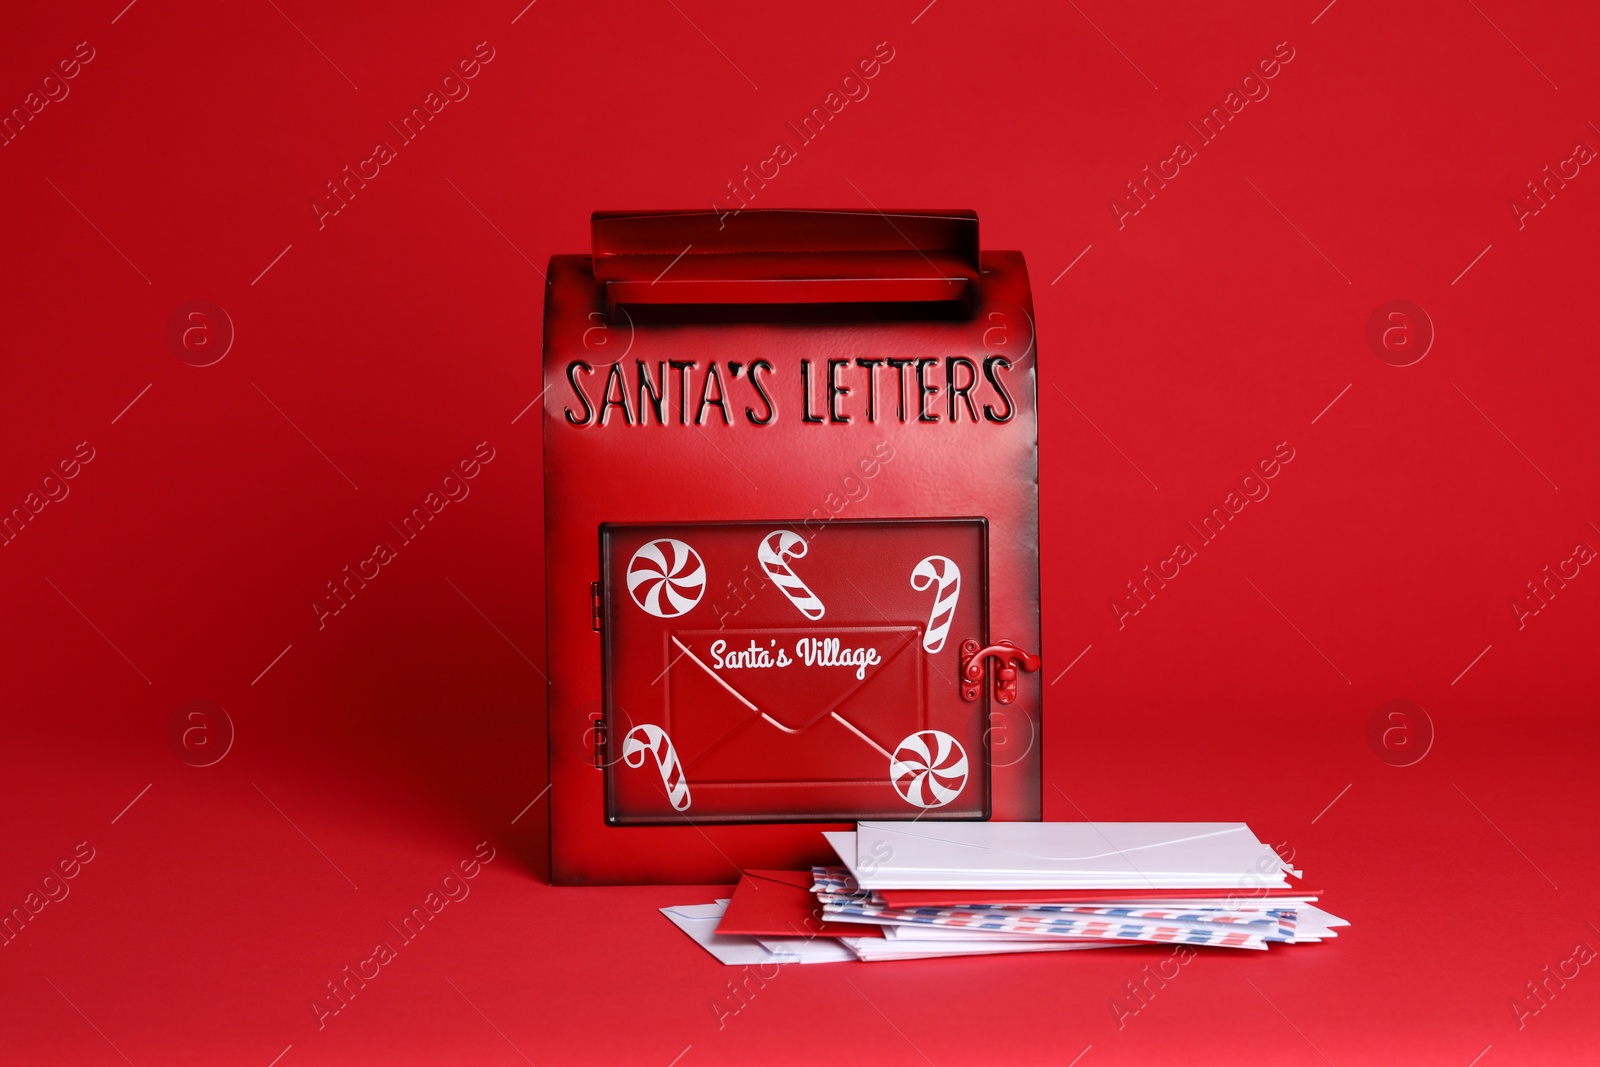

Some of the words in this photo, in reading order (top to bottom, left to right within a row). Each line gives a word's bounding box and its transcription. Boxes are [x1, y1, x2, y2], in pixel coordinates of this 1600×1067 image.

[564, 358, 779, 427] SANTA'S
[800, 354, 1017, 425] LETTERS
[710, 639, 793, 670] Santa's
[795, 637, 882, 680] Village
